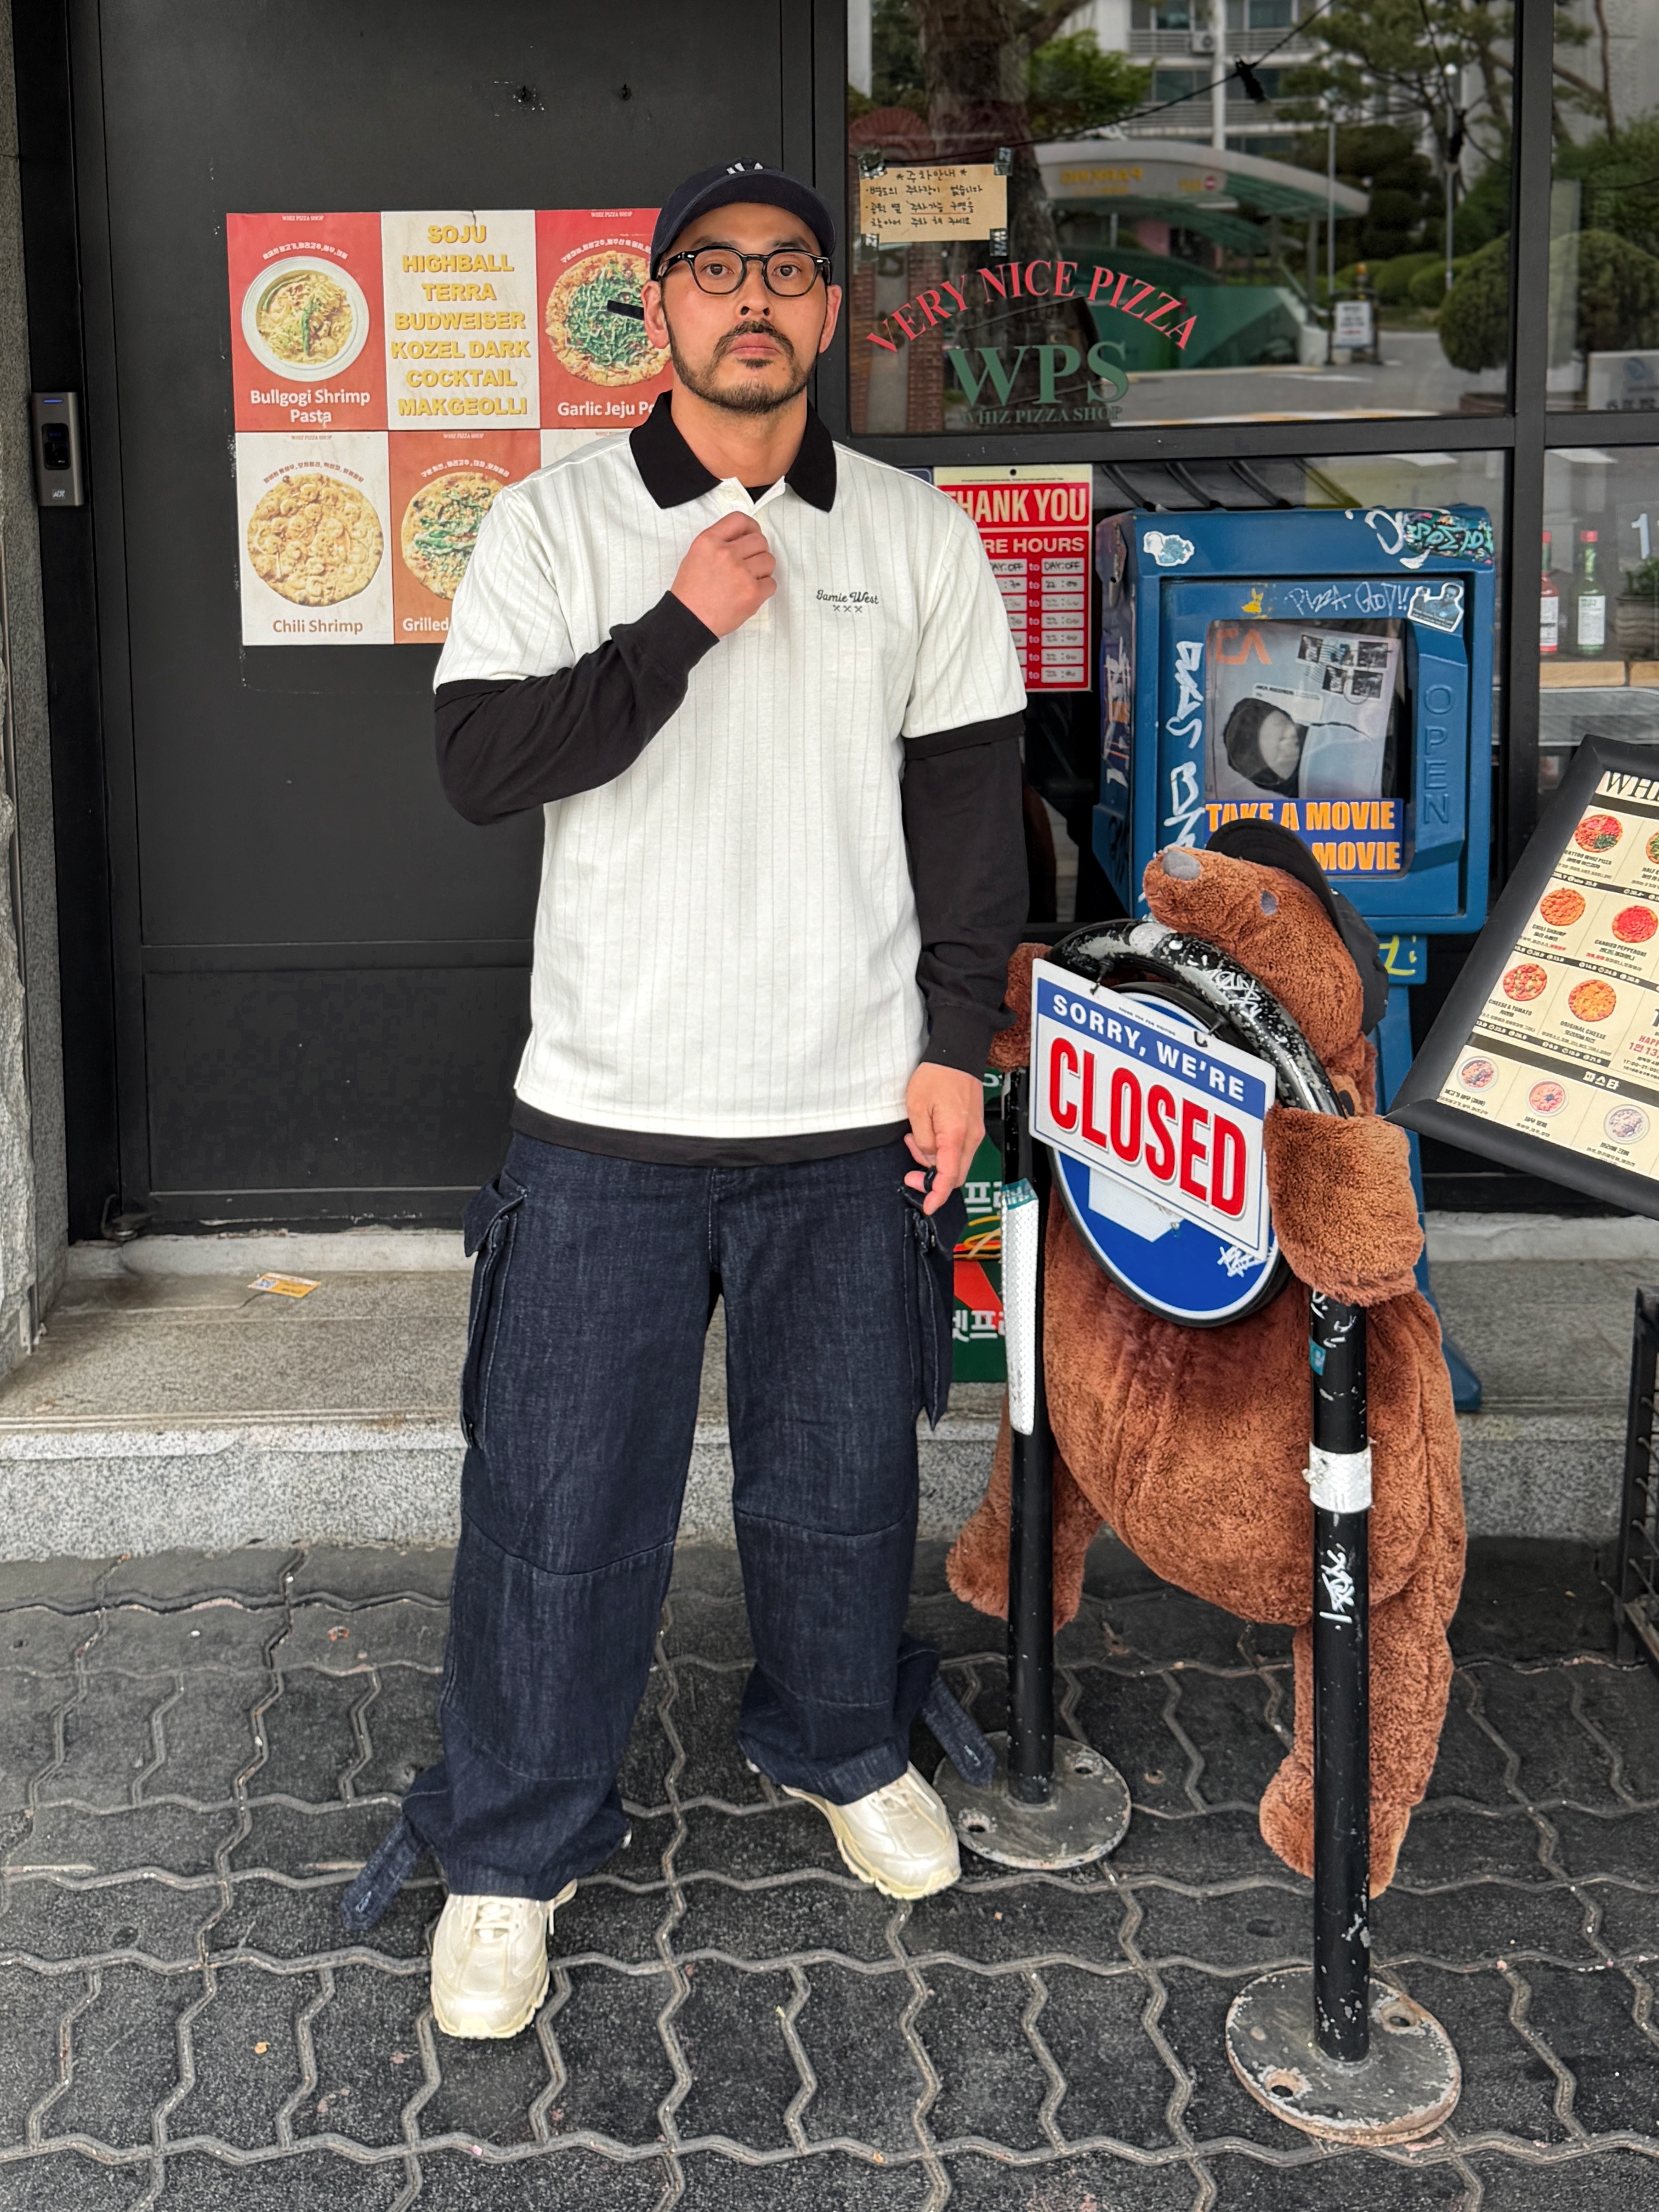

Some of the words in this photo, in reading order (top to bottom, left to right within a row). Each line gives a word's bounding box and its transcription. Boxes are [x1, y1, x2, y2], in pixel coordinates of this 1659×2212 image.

[427, 224, 487, 244] SOJU
[402, 254, 515, 273] HIGHBALL
[421, 283, 497, 302] TERRA
[866, 274, 969, 355] VERY
[977, 260, 1078, 304] NICE
[1088, 266, 1198, 350] PIZZA
[394, 311, 526, 331] BUDWEISER
[391, 341, 465, 360] KOZEL
[469, 339, 531, 358] DARK
[406, 370, 518, 388] COCKTAIL
[945, 341, 1129, 407] WPS
[251, 389, 312, 407] Bullgogi
[315, 389, 371, 406] Shrimp
[398, 397, 528, 417] MAKGEOLLI
[290, 409, 333, 423] Pasta
[557, 401, 603, 416] Garlic
[604, 401, 636, 419] Jeju
[1015, 407, 1069, 423] PIZZA
[1072, 405, 1123, 422] SHOP
[945, 489, 1029, 523] HANK
[1033, 488, 1087, 522] YOU
[1013, 537, 1085, 553] HOURS
[1029, 562, 1040, 571] to
[1029, 580, 1040, 589] to
[816, 589, 848, 603] Jamie
[849, 591, 879, 605] West
[1029, 599, 1040, 607] to
[273, 619, 305, 633] Chili
[309, 618, 364, 635] Shrimp
[402, 617, 450, 632] Grilled
[1029, 617, 1040, 625] to
[1029, 635, 1040, 643] to
[1029, 653, 1040, 661] to
[1029, 671, 1040, 679] to
[1280, 802, 1300, 831] A
[1306, 801, 1395, 831] MOVIE
[1312, 842, 1401, 871] MOVIE
[1052, 994, 1147, 1057] SORRY,
[1156, 1041, 1245, 1102] WE'RE
[1048, 1037, 1247, 1218] CLOSED
